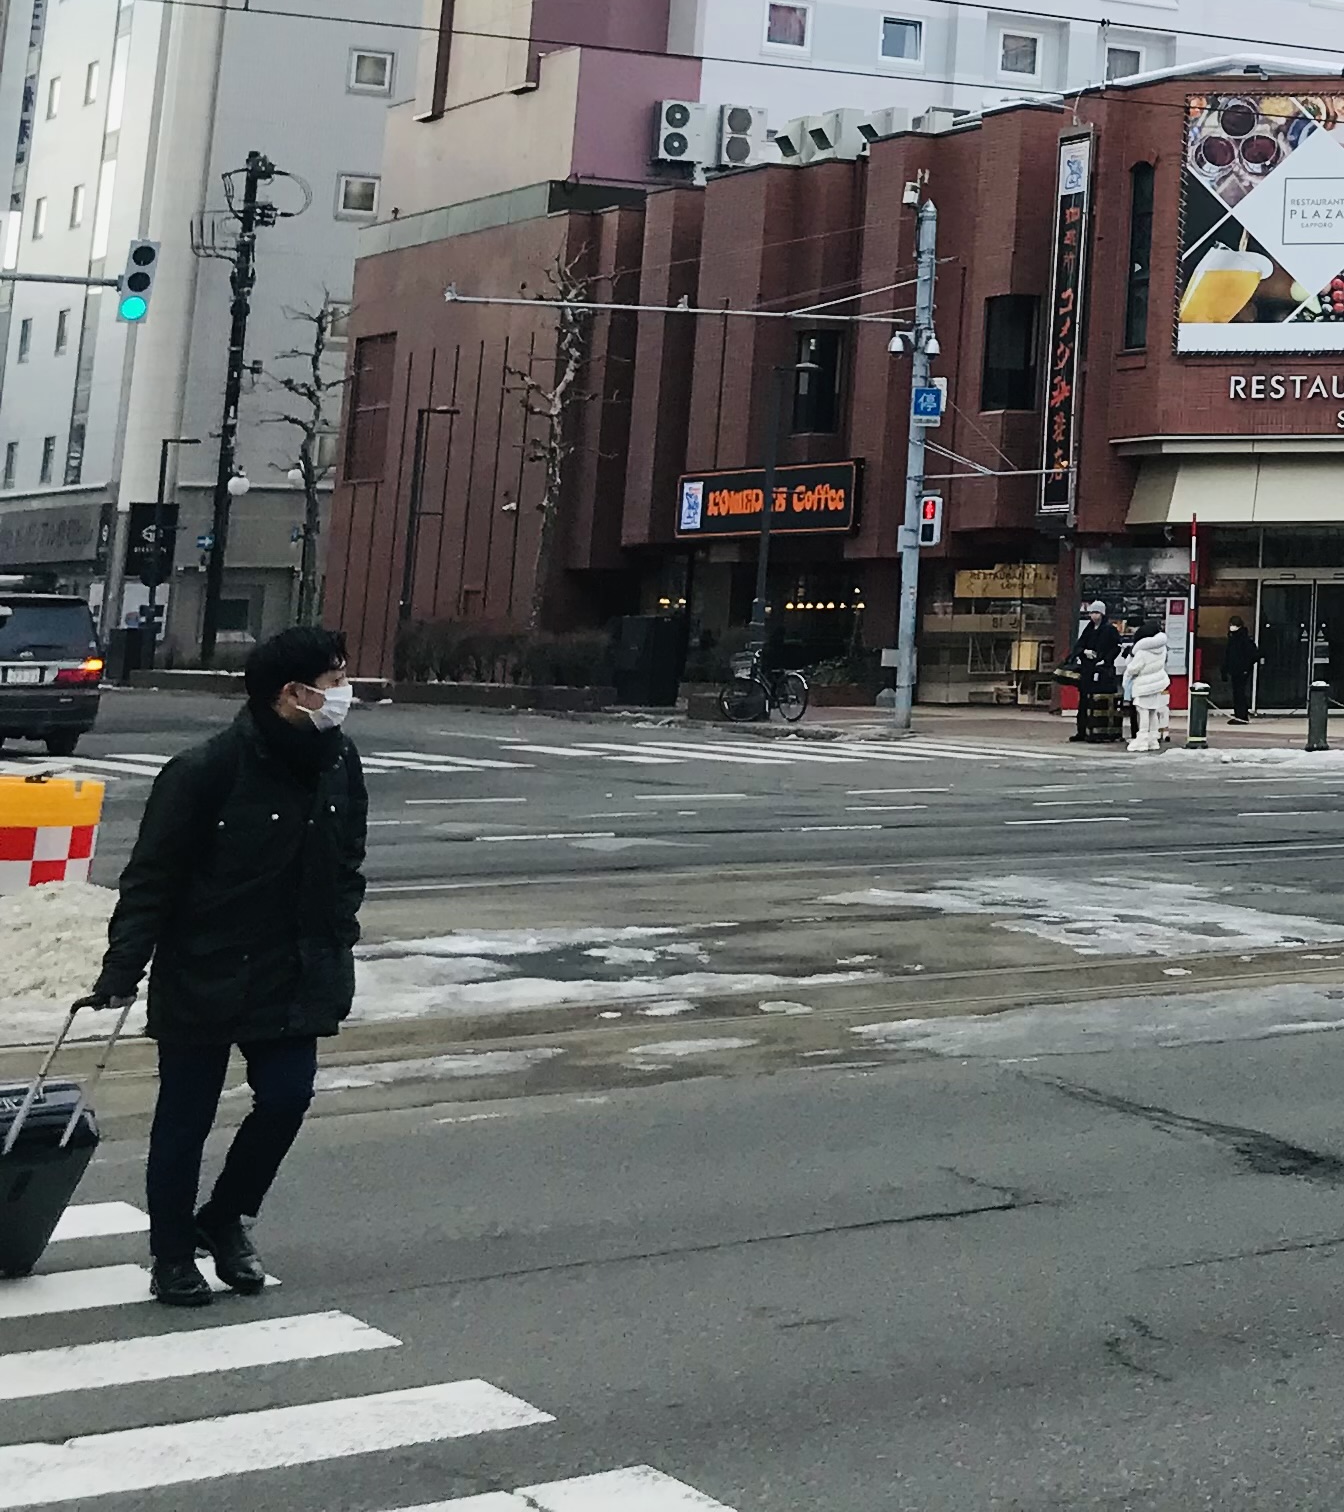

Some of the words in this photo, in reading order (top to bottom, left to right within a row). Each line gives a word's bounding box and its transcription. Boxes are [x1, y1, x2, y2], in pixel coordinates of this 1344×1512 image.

[1290, 198, 1344, 206] RESTAURANT
[1290, 209, 1344, 219] PLAZA
[918, 393, 937, 411] 停
[792, 484, 845, 513] Coffee
